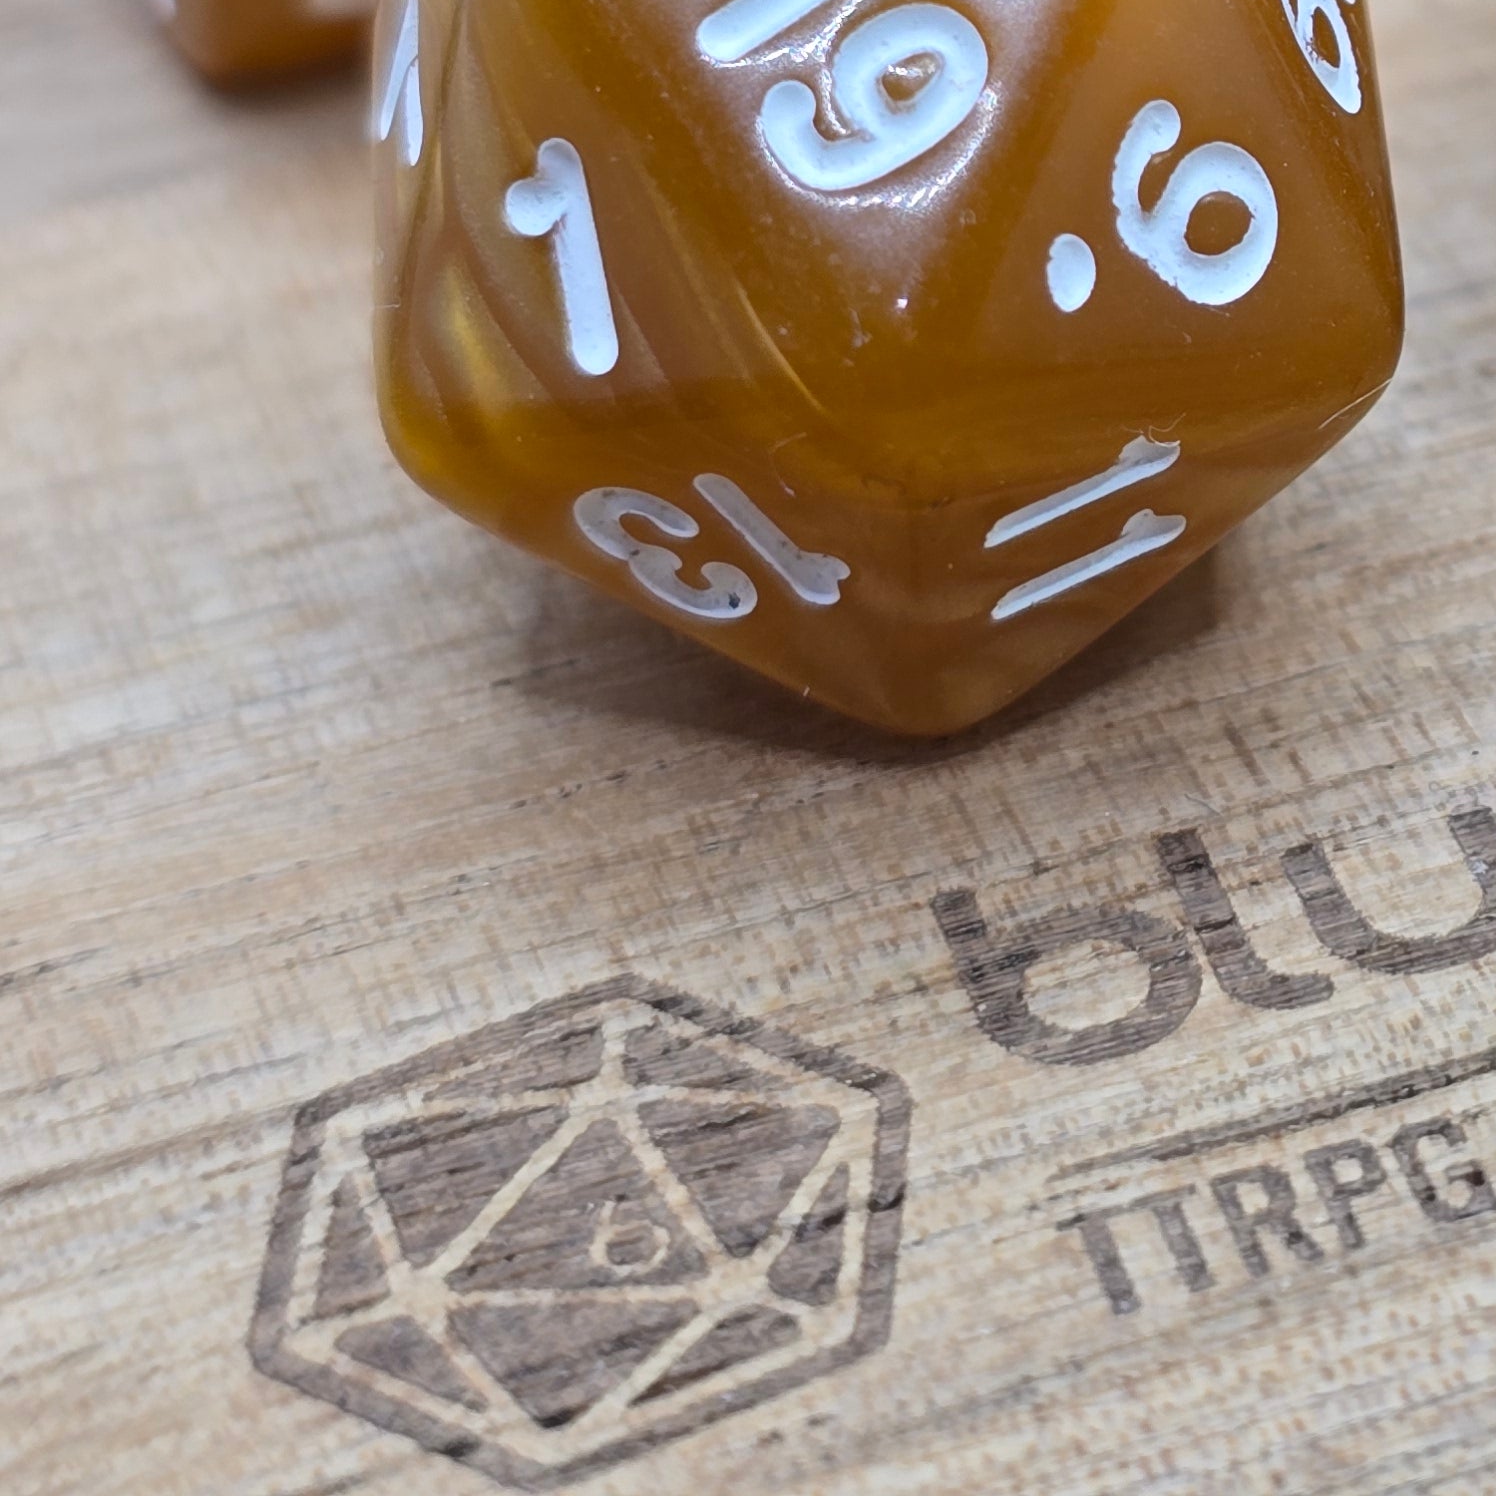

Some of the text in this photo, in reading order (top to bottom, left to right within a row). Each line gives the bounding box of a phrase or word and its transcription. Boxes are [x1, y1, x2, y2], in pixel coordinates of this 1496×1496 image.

[504, 136, 620, 376] 1
[572, 471, 850, 621] 13
[982, 434, 1188, 621] 11
